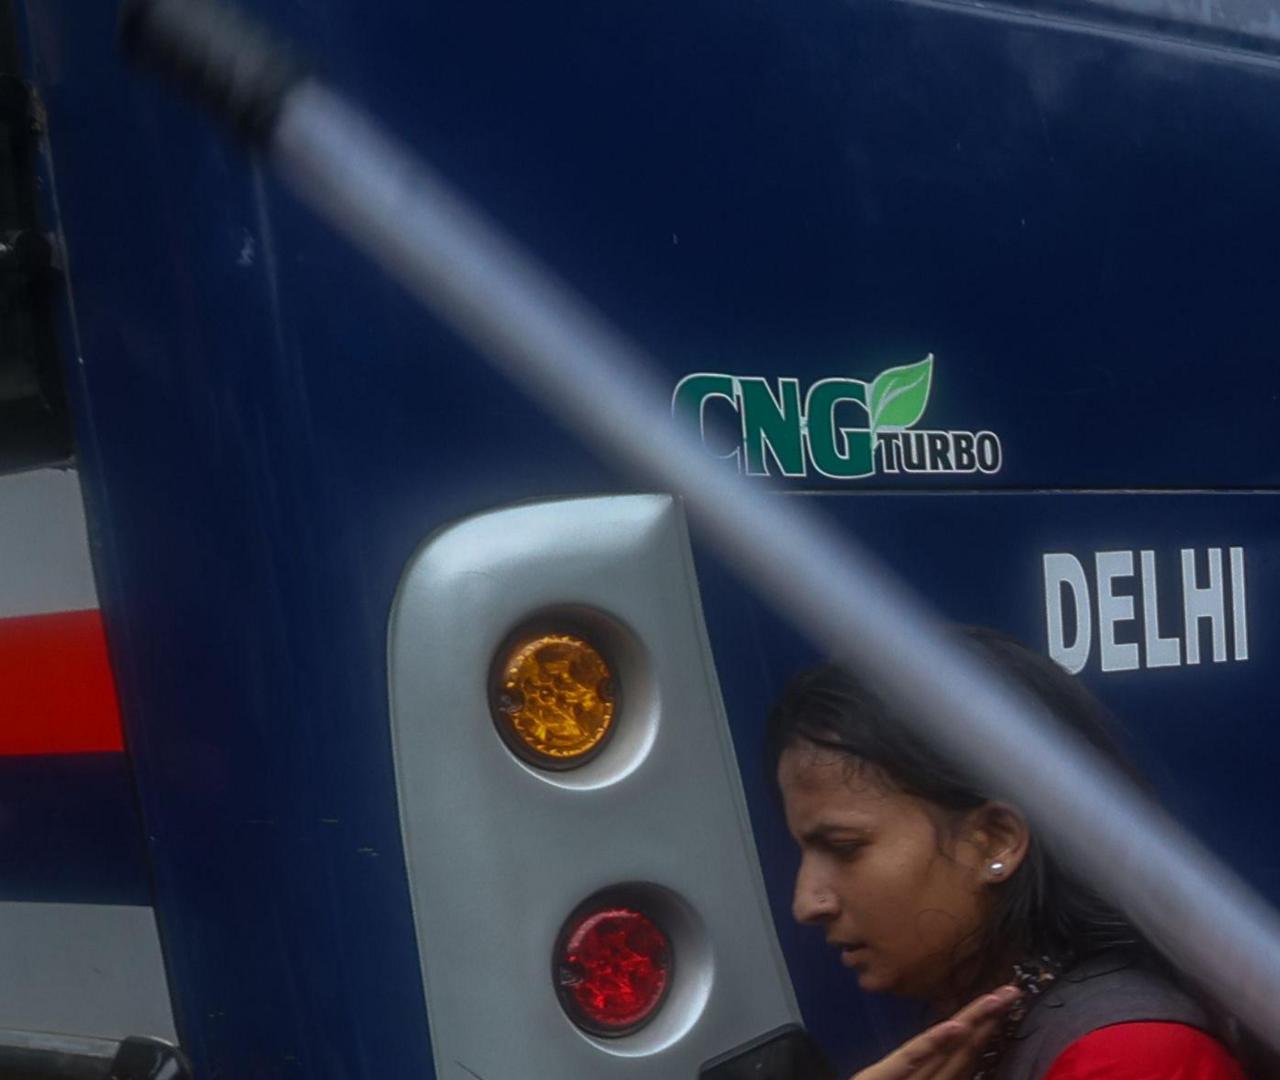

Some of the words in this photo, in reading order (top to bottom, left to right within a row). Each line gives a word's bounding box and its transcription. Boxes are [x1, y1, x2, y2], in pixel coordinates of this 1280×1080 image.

[672, 373, 876, 479] CNG
[873, 430, 1002, 475] TURBO
[1043, 546, 1248, 676] DELHI
